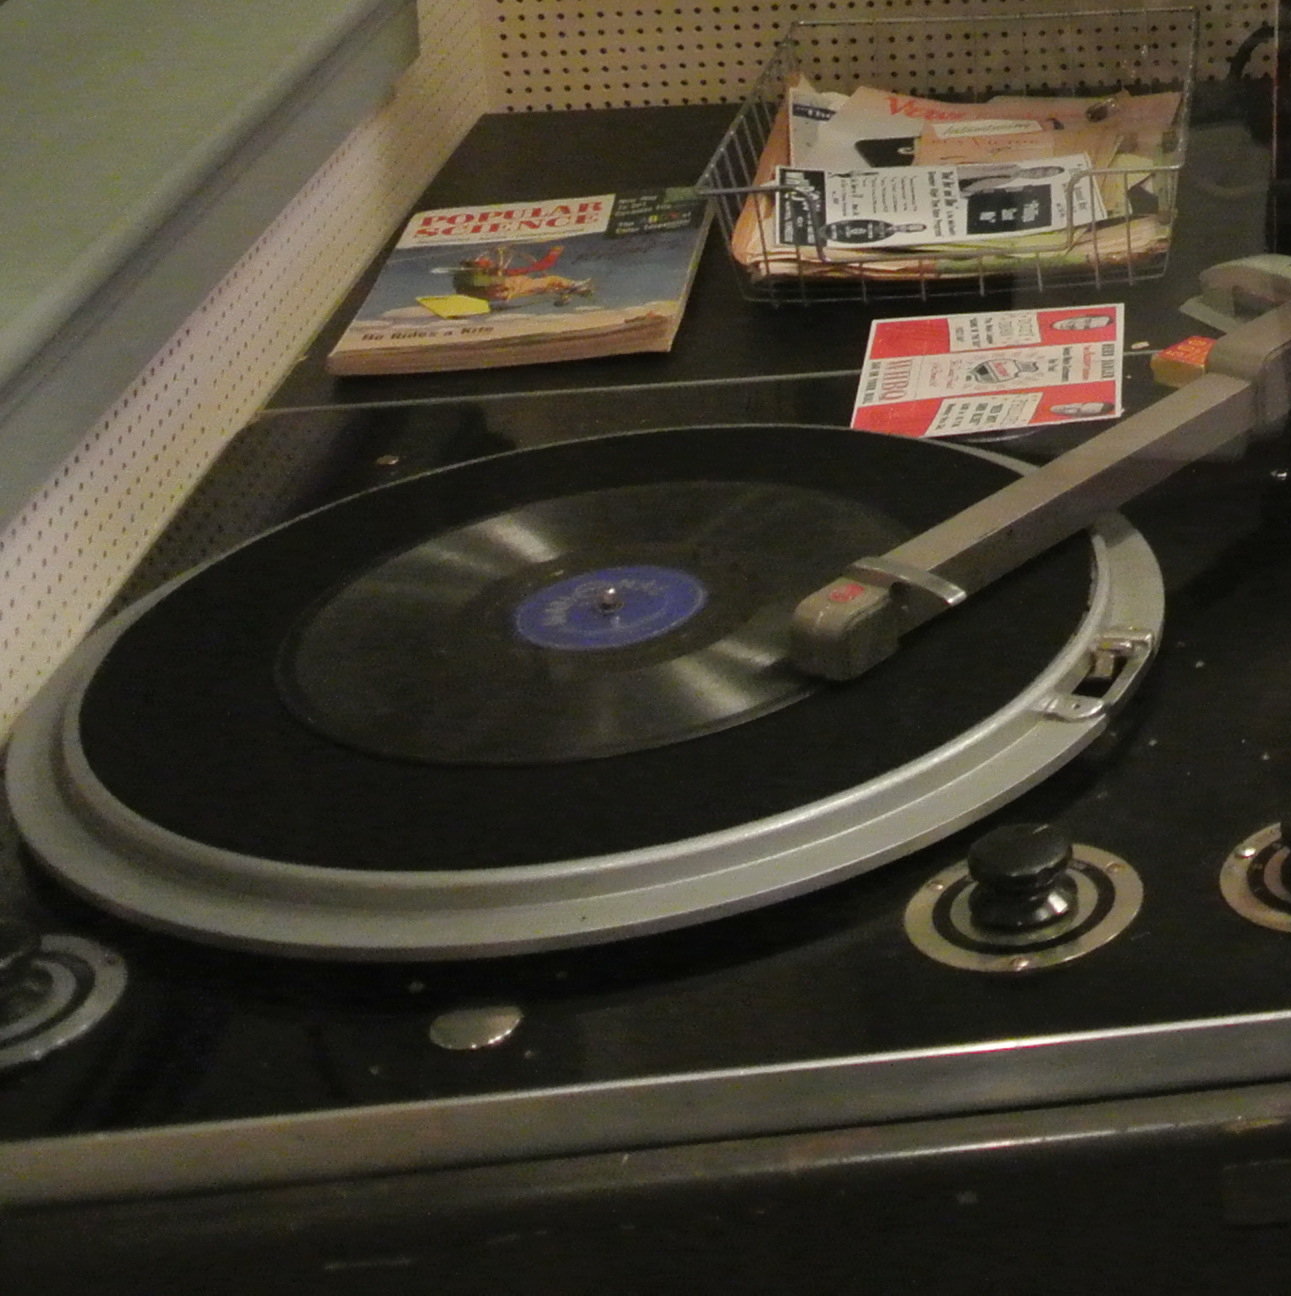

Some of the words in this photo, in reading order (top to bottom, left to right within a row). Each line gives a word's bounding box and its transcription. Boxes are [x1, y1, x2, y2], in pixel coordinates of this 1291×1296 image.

[413, 214, 599, 238] SCIENCE
[421, 201, 603, 227] POPULAR
[879, 359, 912, 400] WHBQ
